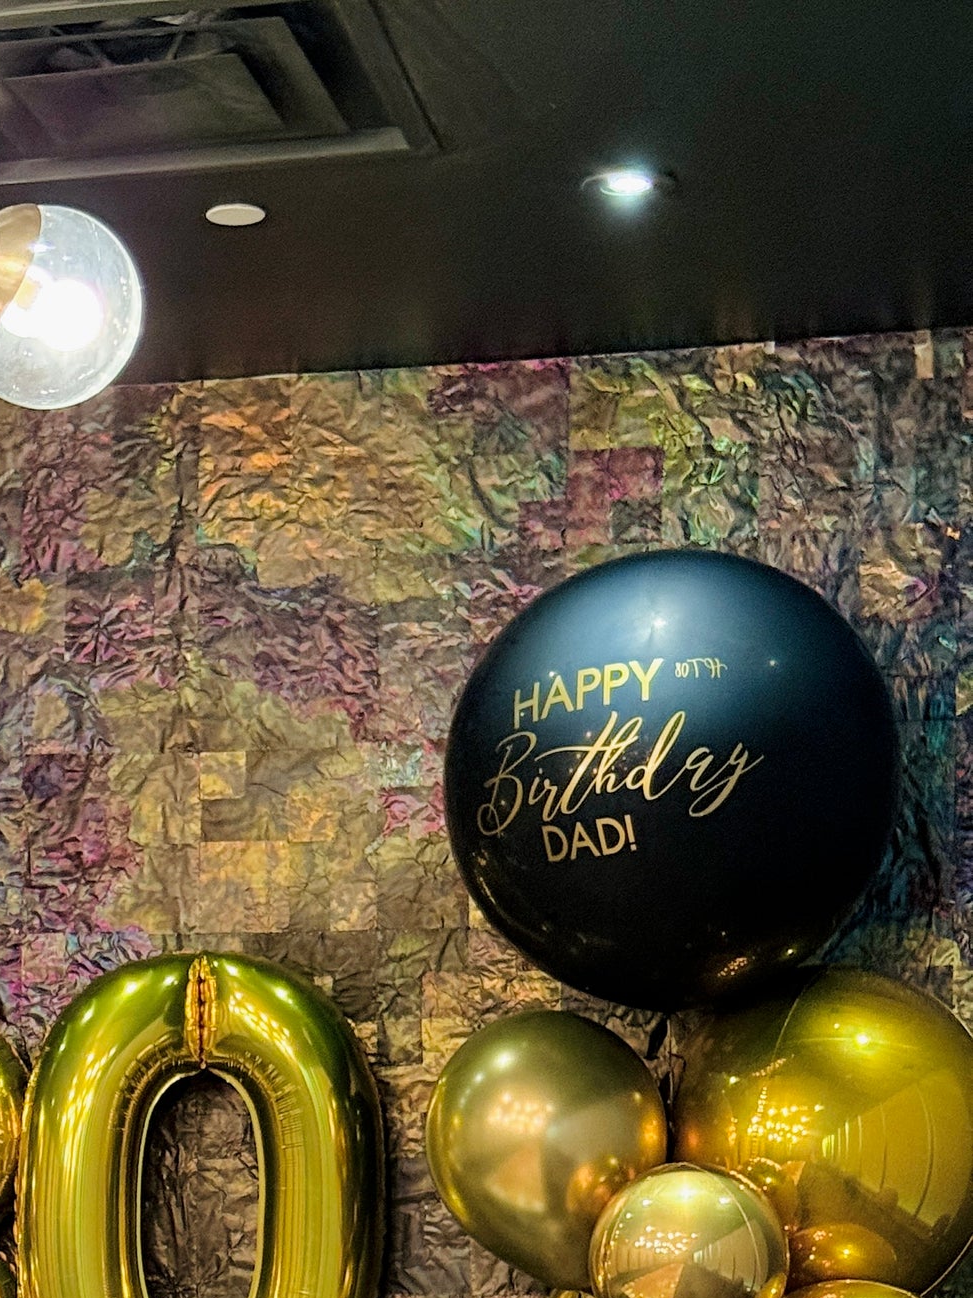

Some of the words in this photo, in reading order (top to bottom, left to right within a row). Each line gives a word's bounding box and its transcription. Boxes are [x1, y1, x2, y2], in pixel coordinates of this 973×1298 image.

[512, 658, 665, 729] HAPPY
[476, 711, 765, 836] Birthday
[541, 815, 637, 862] DAD!
